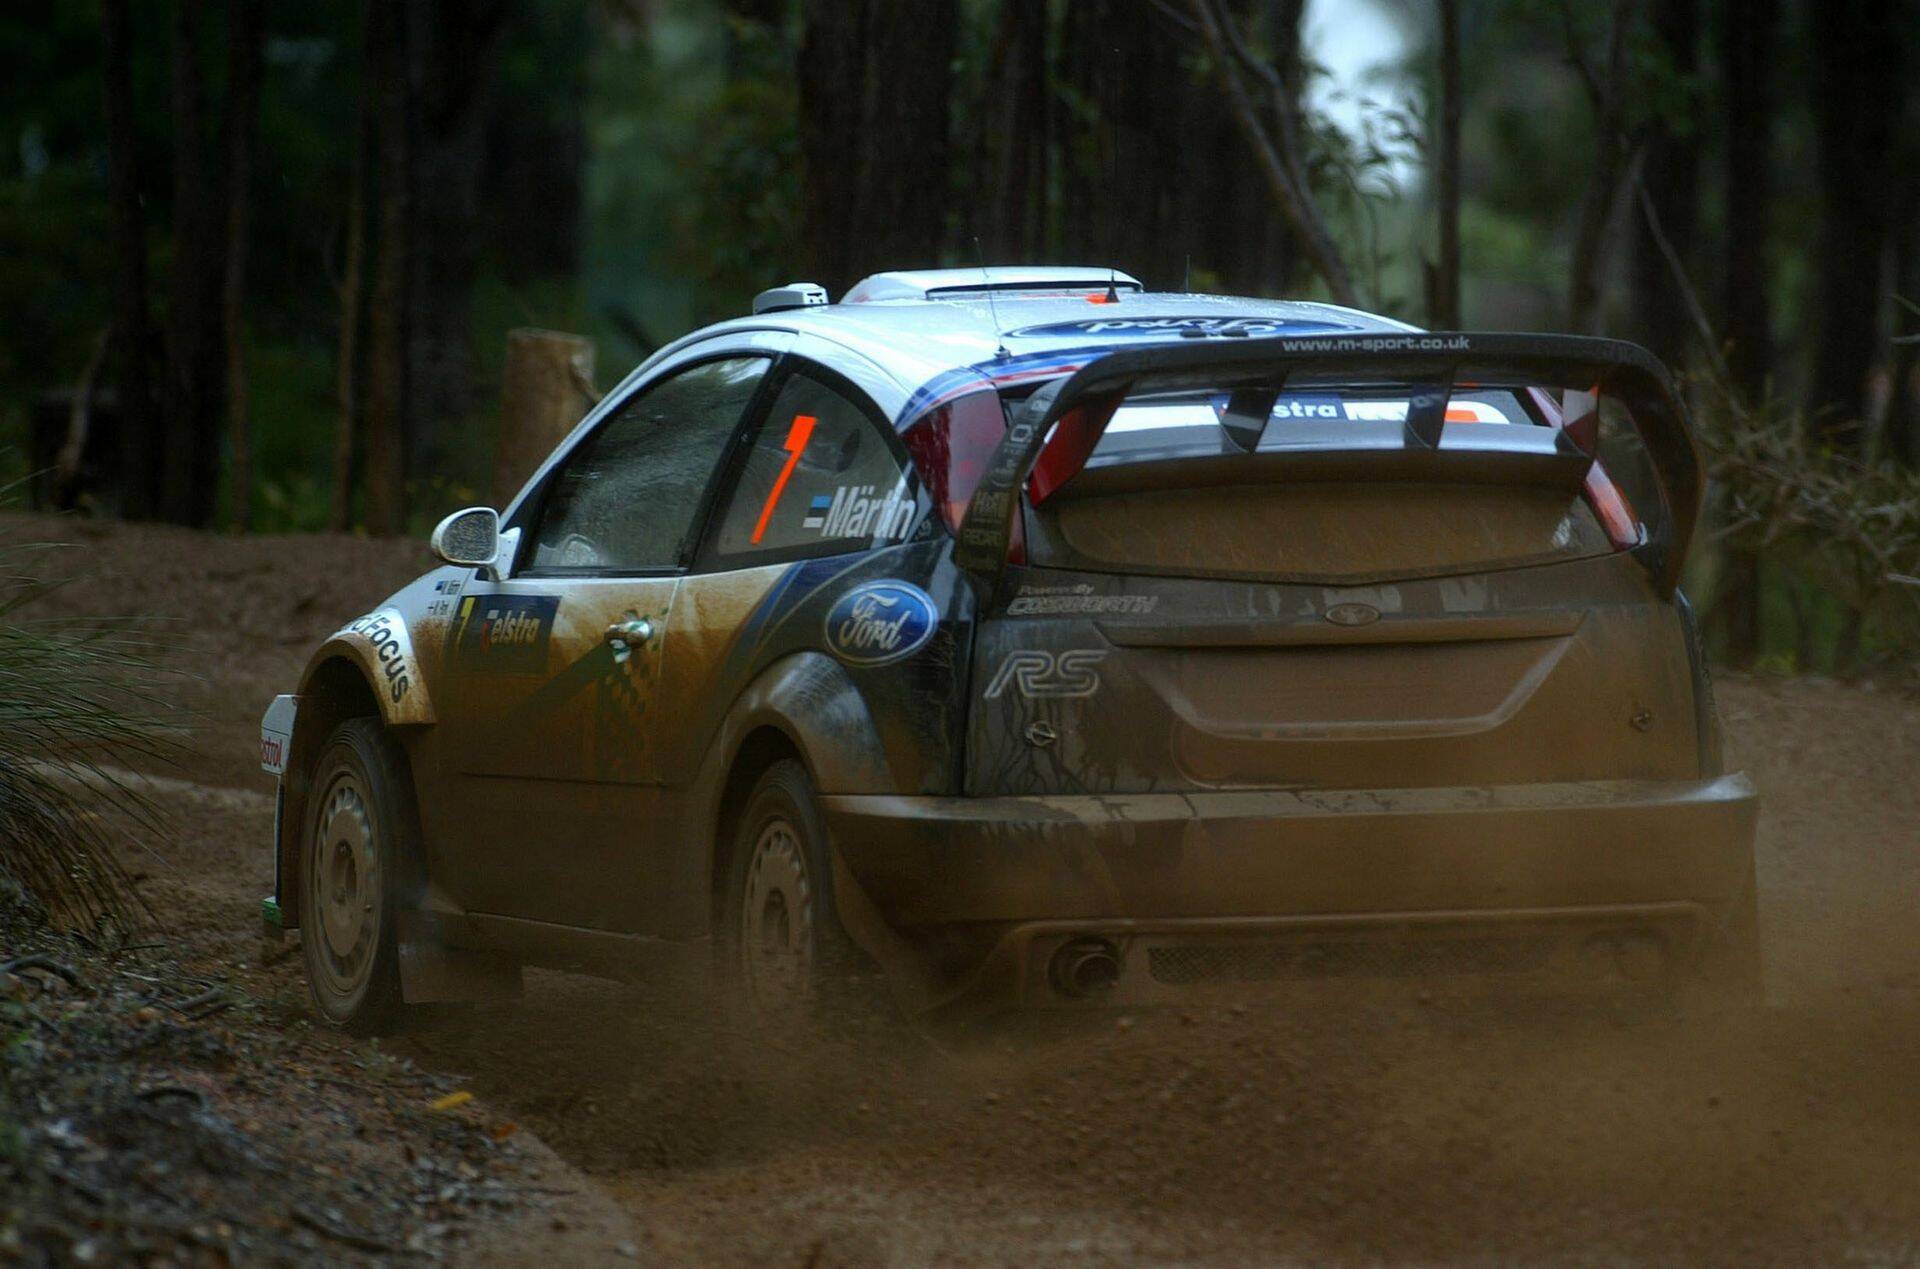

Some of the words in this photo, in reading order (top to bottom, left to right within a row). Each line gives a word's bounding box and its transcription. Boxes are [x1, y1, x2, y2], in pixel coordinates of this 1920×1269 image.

[1282, 335, 1470, 353] www.m-sport.co.uk
[1272, 401, 1338, 419] stra
[821, 485, 918, 540] Märtin
[838, 591, 913, 652] Ford
[982, 648, 1112, 700] RS
